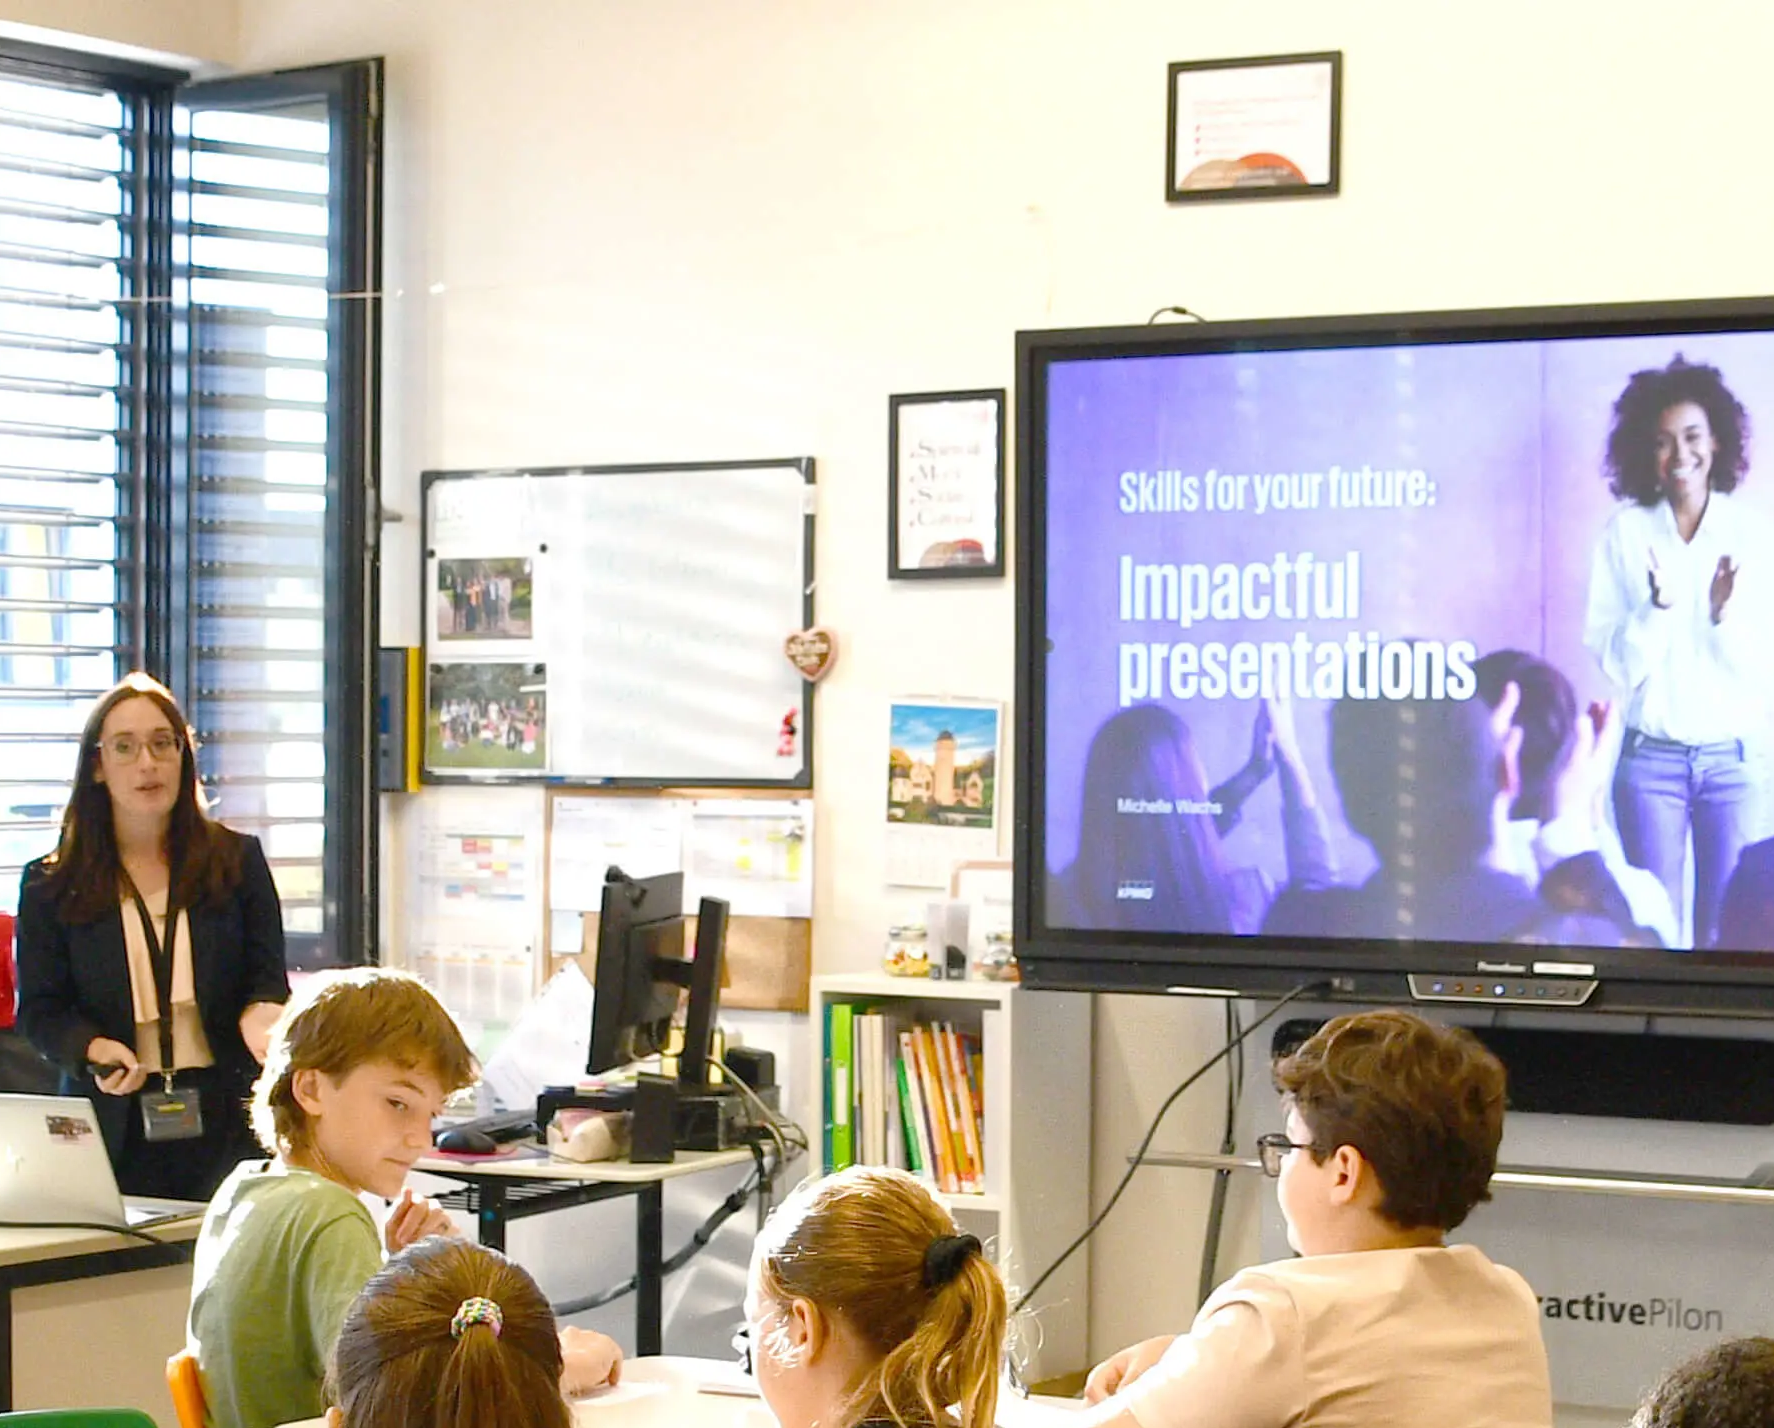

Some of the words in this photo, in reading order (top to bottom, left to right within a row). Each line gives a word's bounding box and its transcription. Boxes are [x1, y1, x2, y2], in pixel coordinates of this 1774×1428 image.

[1120, 470, 1199, 513] Skills
[1204, 468, 1249, 512] for
[1253, 470, 1323, 515] your
[1328, 464, 1437, 508] future:
[1119, 550, 1361, 629] Impactful
[1119, 630, 1478, 708] presentations
